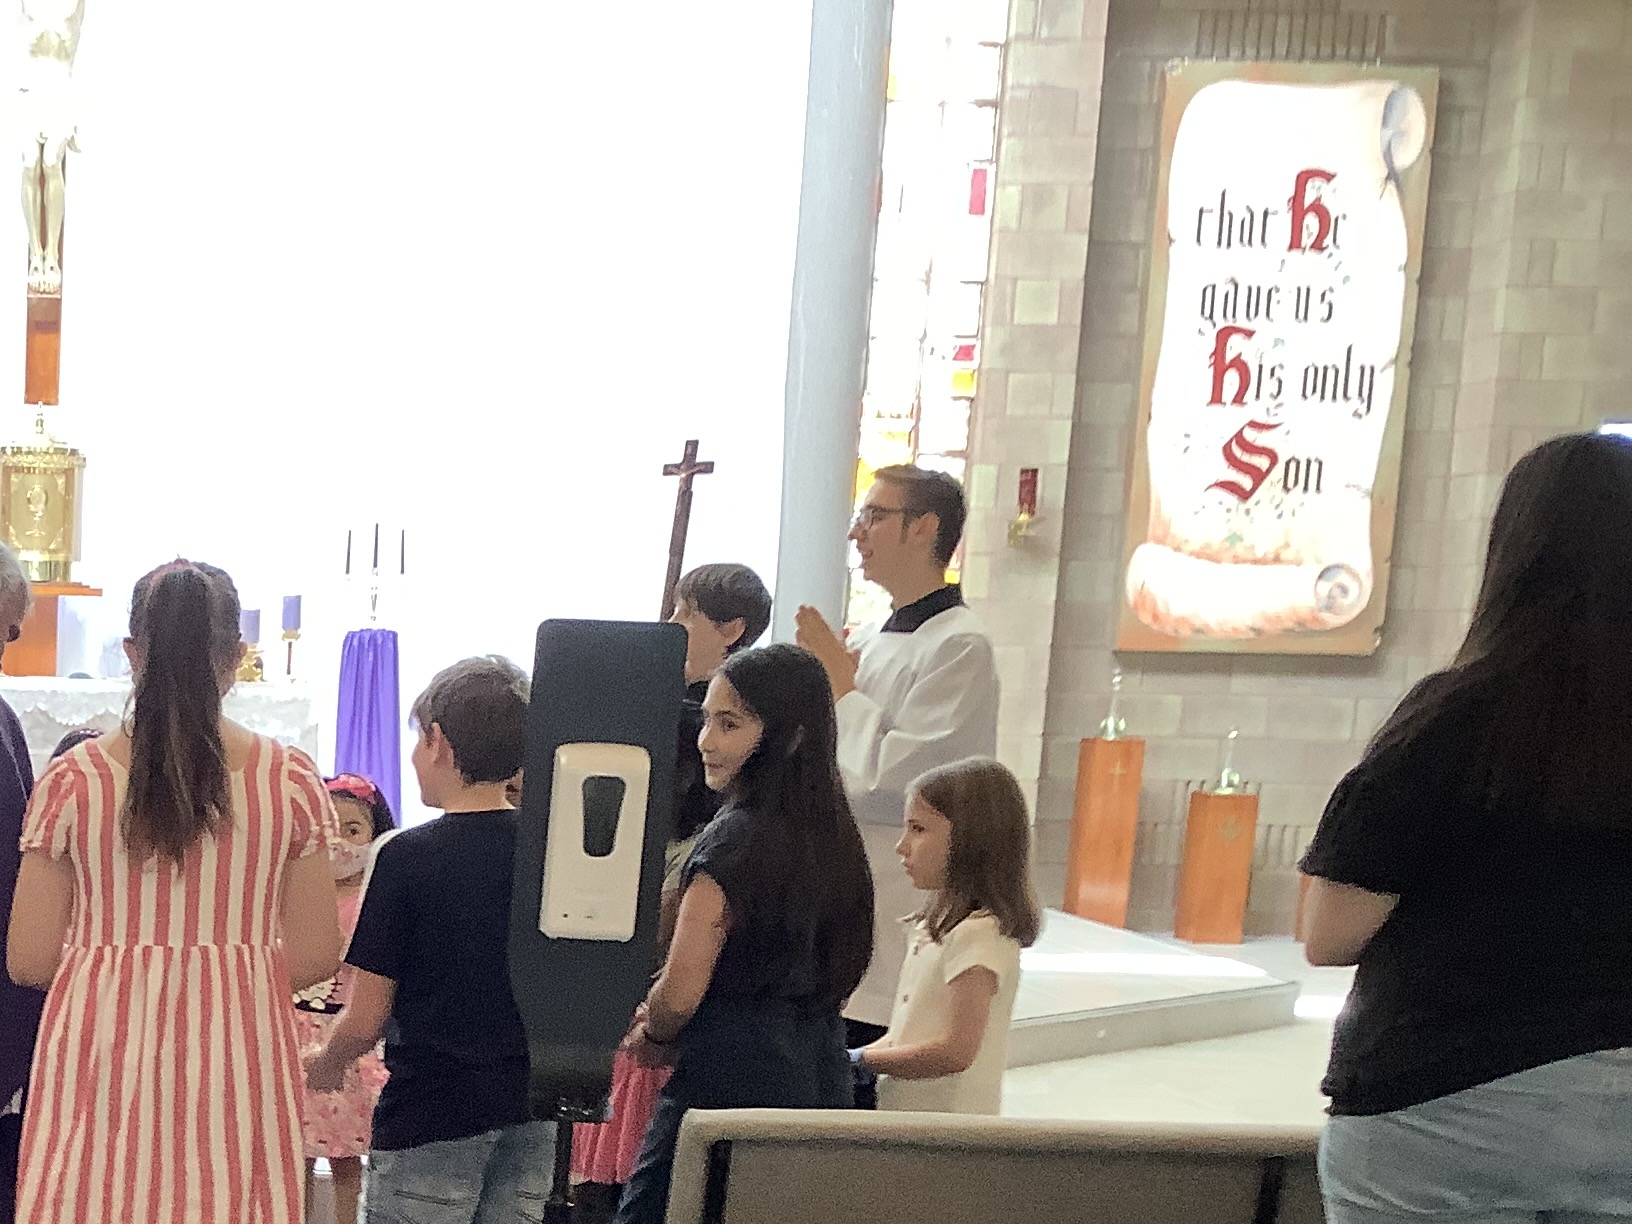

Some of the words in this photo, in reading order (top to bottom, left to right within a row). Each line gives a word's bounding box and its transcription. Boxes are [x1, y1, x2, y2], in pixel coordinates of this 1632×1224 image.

[1196, 188, 1279, 250] that
[1287, 167, 1347, 256] He
[1199, 276, 1281, 329] gave
[1295, 284, 1335, 323] us
[1206, 324, 1285, 408] His
[1301, 343, 1375, 420] only
[1204, 418, 1324, 504] Son
